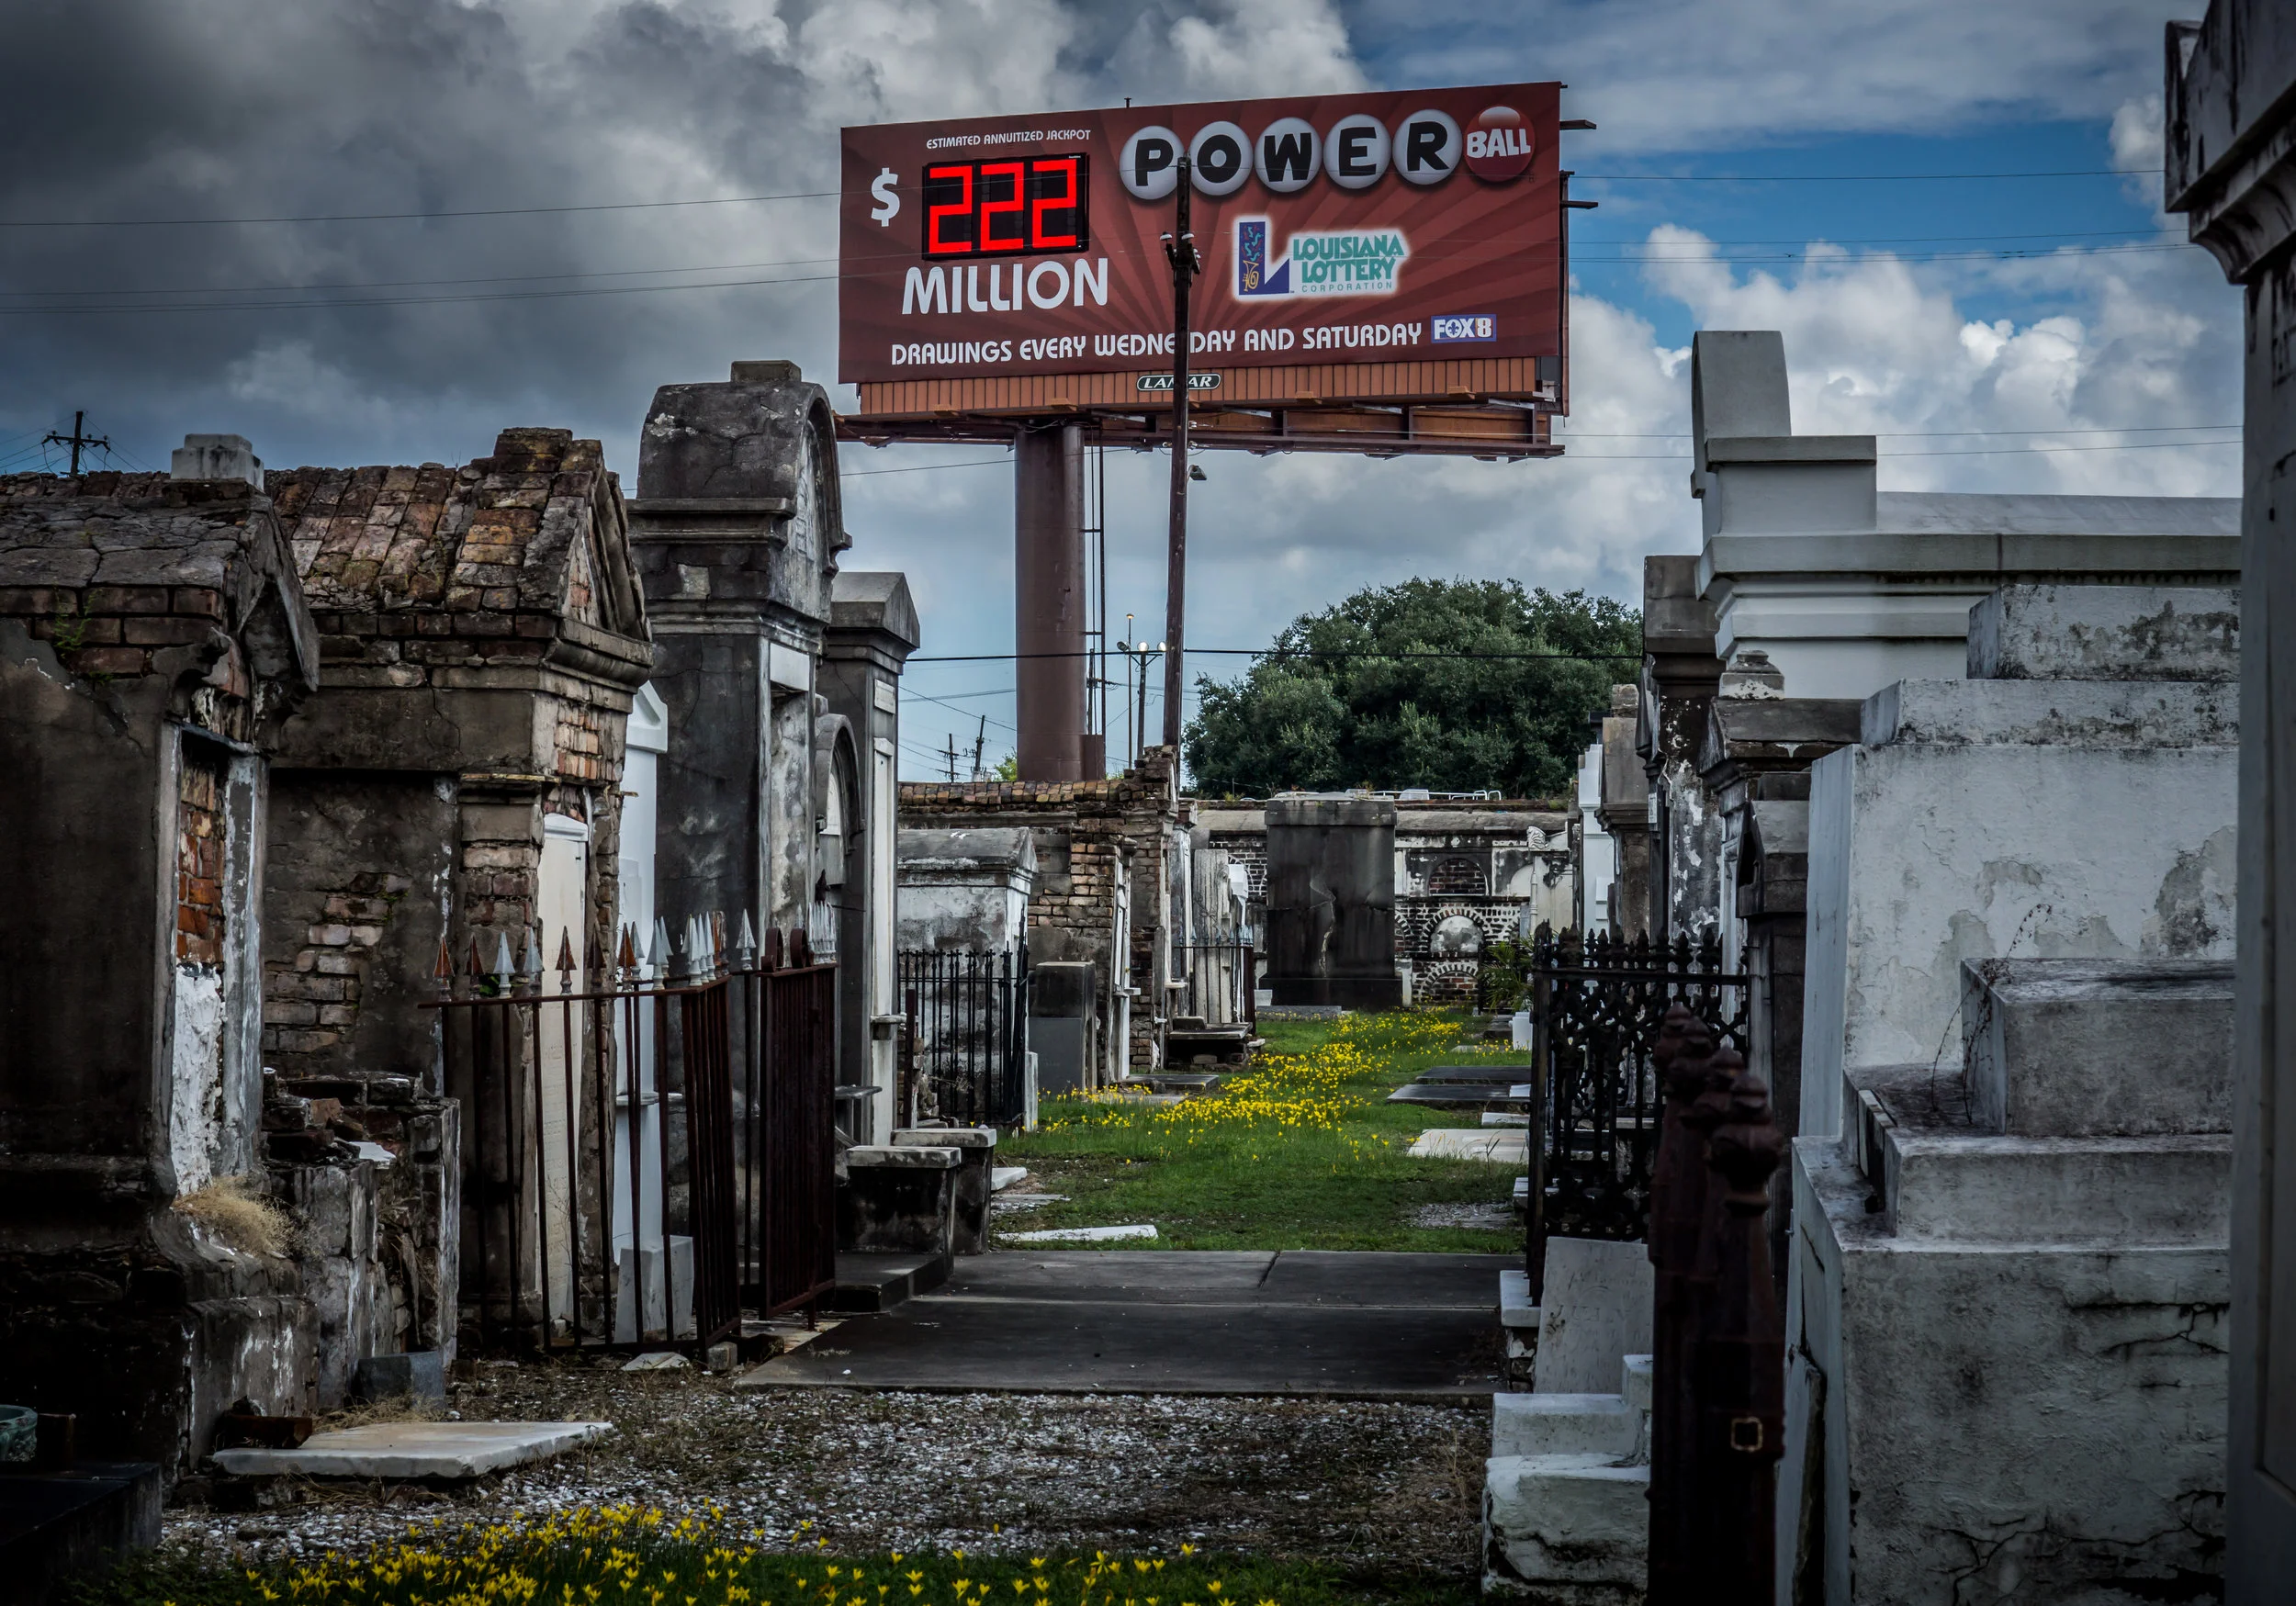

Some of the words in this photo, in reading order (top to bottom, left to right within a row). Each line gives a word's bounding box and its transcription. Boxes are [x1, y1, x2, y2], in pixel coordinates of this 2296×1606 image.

[927, 136, 980, 149] ESTIMATED
[984, 131, 1044, 144] ANNUITIZED
[1046, 129, 1091, 141] JACKPOT
[1135, 121, 1448, 186] POWER
[1467, 129, 1531, 158] BALL
[871, 167, 900, 227] $
[929, 159, 1077, 253] 222
[1293, 235, 1404, 261] LOUISIANA
[901, 258, 1108, 315] MILLION
[1301, 259, 1396, 284] LOTTERY
[1301, 281, 1392, 293] CORPORATION
[891, 341, 1012, 365] DRAWINGS
[1019, 335, 1086, 361] EVERY
[1095, 330, 1235, 356] WEDNEDAY
[1244, 328, 1294, 352] AND
[1302, 322, 1422, 349] SATURDAY
